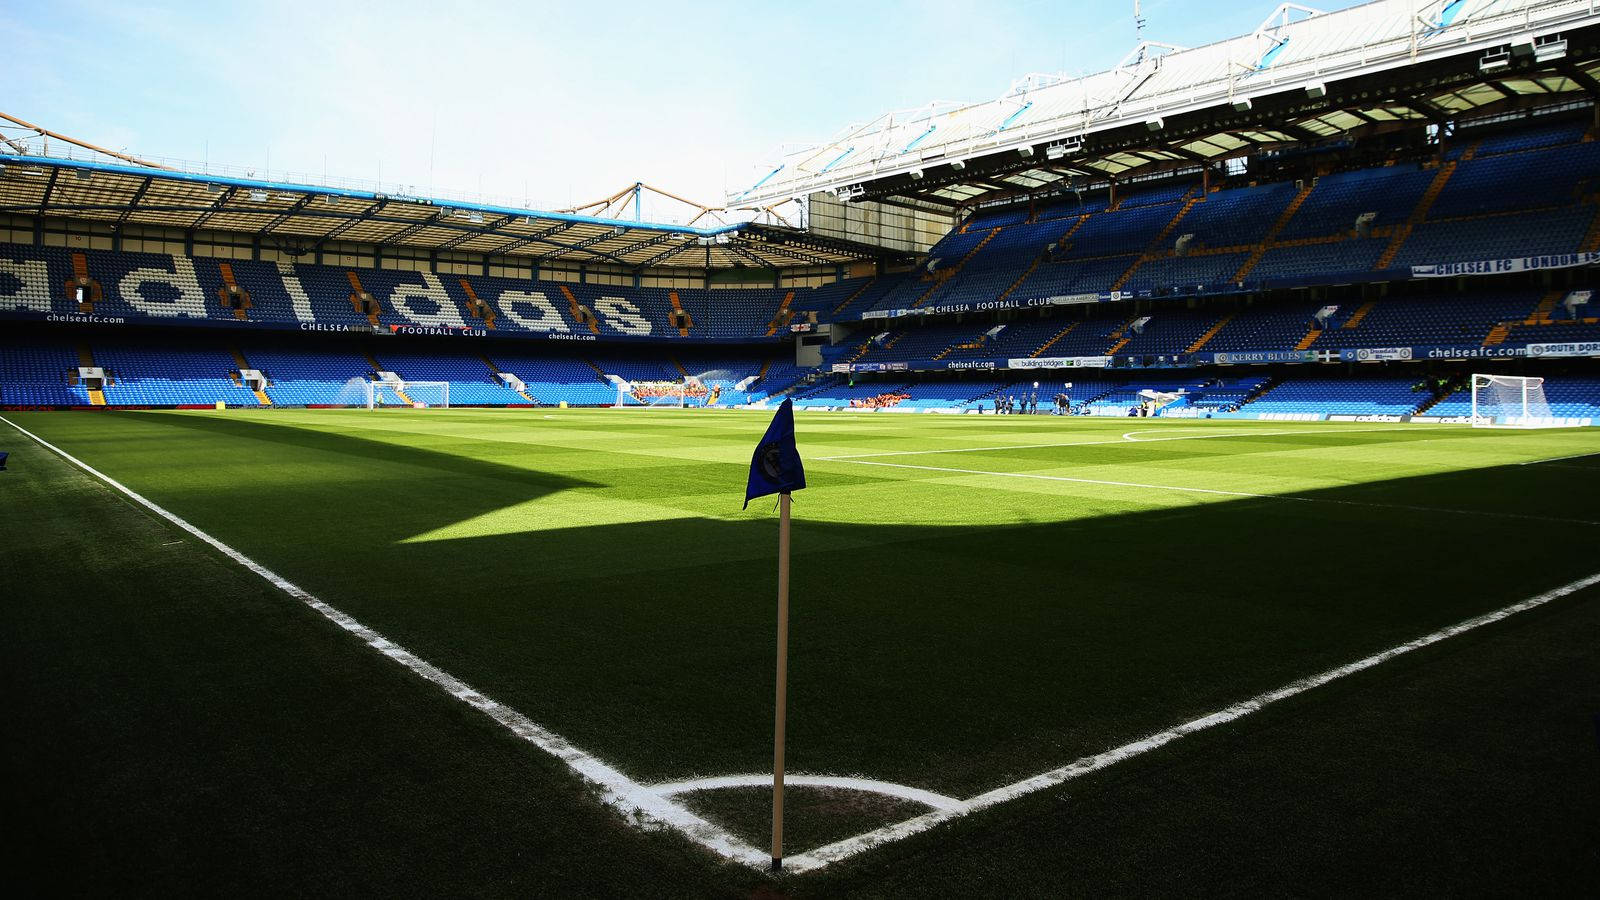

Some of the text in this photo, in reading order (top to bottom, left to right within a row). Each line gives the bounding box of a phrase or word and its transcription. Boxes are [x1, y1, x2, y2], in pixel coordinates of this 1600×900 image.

[1436, 261, 1492, 276] CHELSEA
[1496, 259, 1512, 272] FC
[1523, 253, 1579, 270] LONDON
[935, 297, 1051, 313] CHELSEA FOOTBALL CLUB
[46, 314, 124, 324] chelseafc.com
[300, 322, 487, 337] CHELSEA FOOTBALL CLUB
[548, 332, 596, 341] chelseafc.com
[1428, 346, 1528, 358] chelseafc.com
[1545, 343, 1600, 353] SOUTH DOR
[1231, 351, 1301, 361] KERRY BLUES
[948, 361, 995, 369] chelseafc.com
